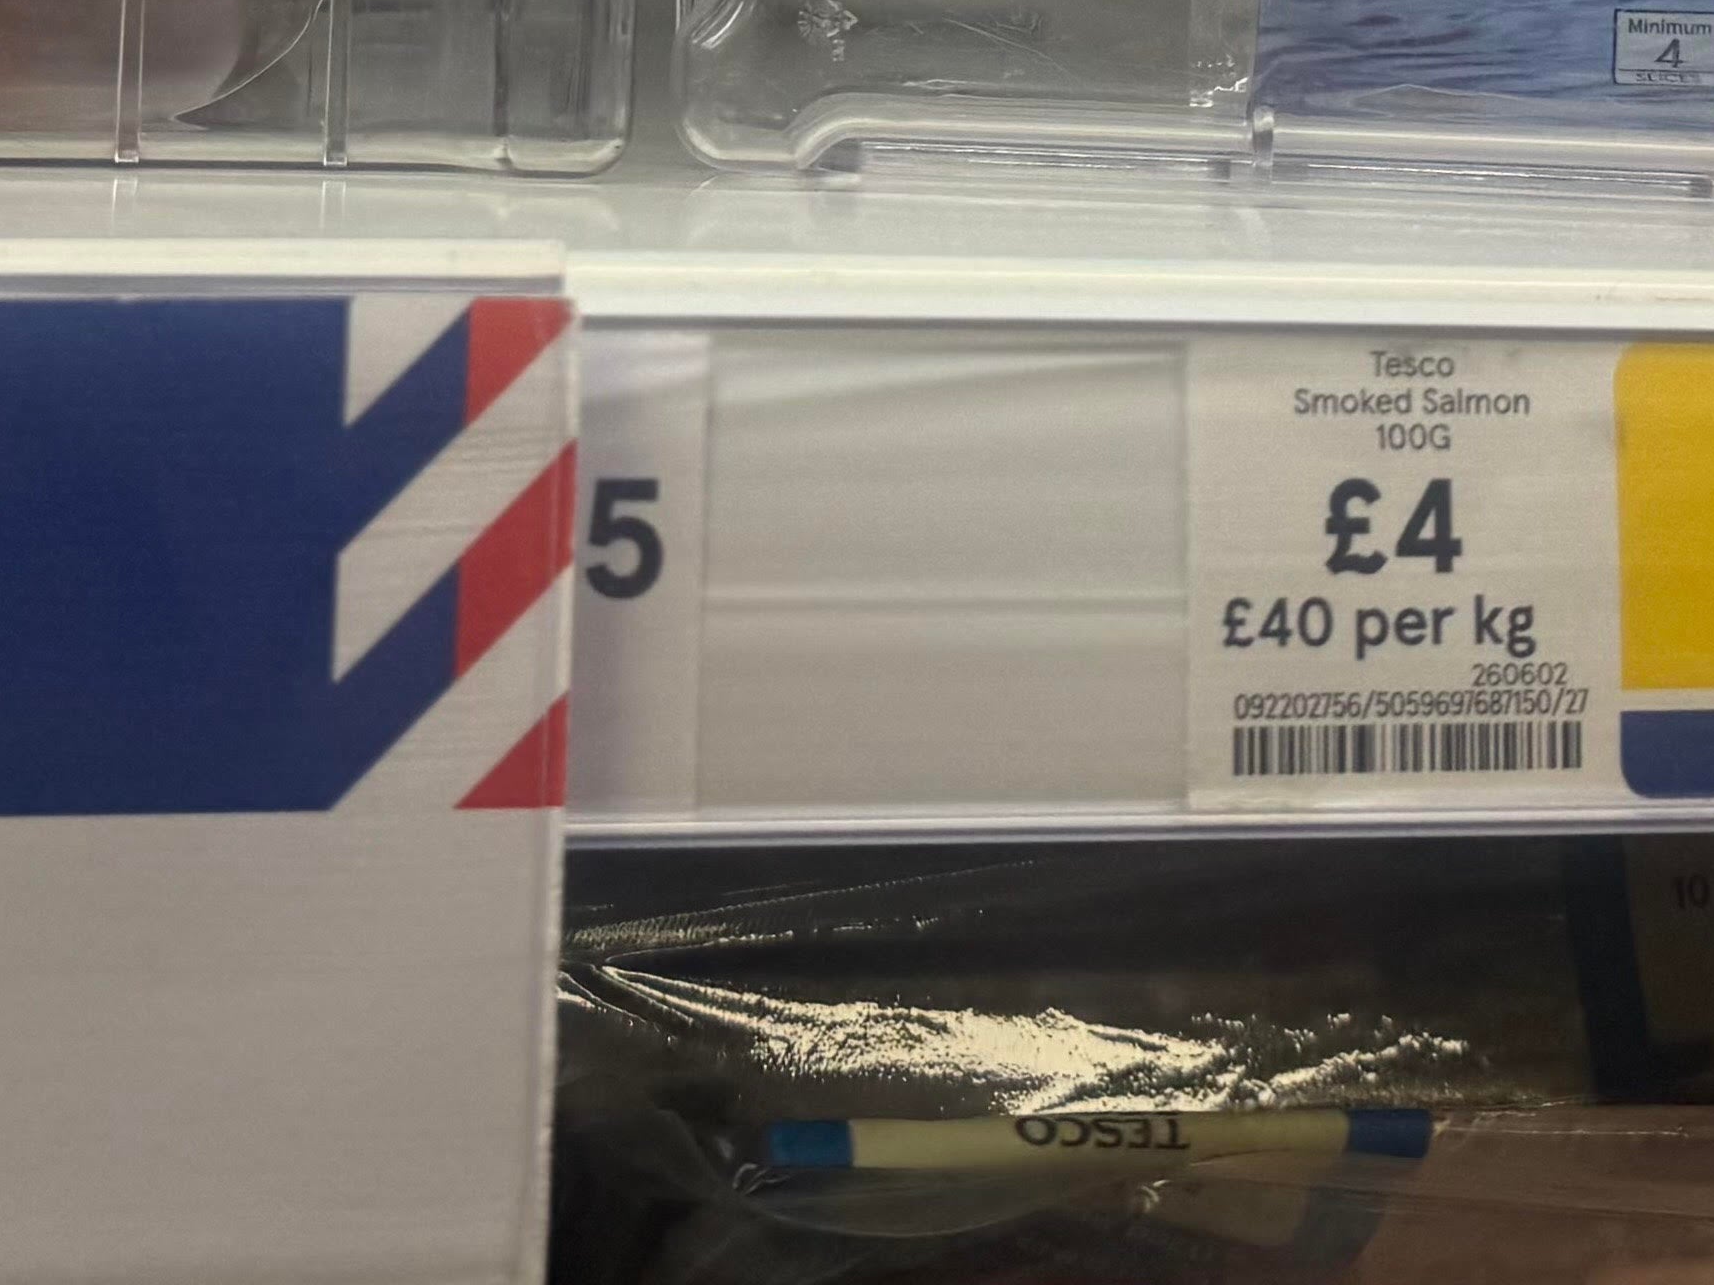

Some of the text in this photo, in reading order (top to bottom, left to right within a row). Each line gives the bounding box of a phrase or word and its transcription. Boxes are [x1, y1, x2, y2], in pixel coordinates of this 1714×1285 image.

[1628, 18, 1712, 35] Minimum
[1654, 38, 1684, 68] 4
[1370, 350, 1455, 377] Tesco
[1294, 387, 1531, 415] Smoked Salmon
[1376, 424, 1452, 451] 100G
[1325, 477, 1463, 575] £4
[1222, 594, 1537, 660] £40 per kg
[1472, 662, 1569, 687] 260602
[1014, 1115, 1191, 1151] TESCO
